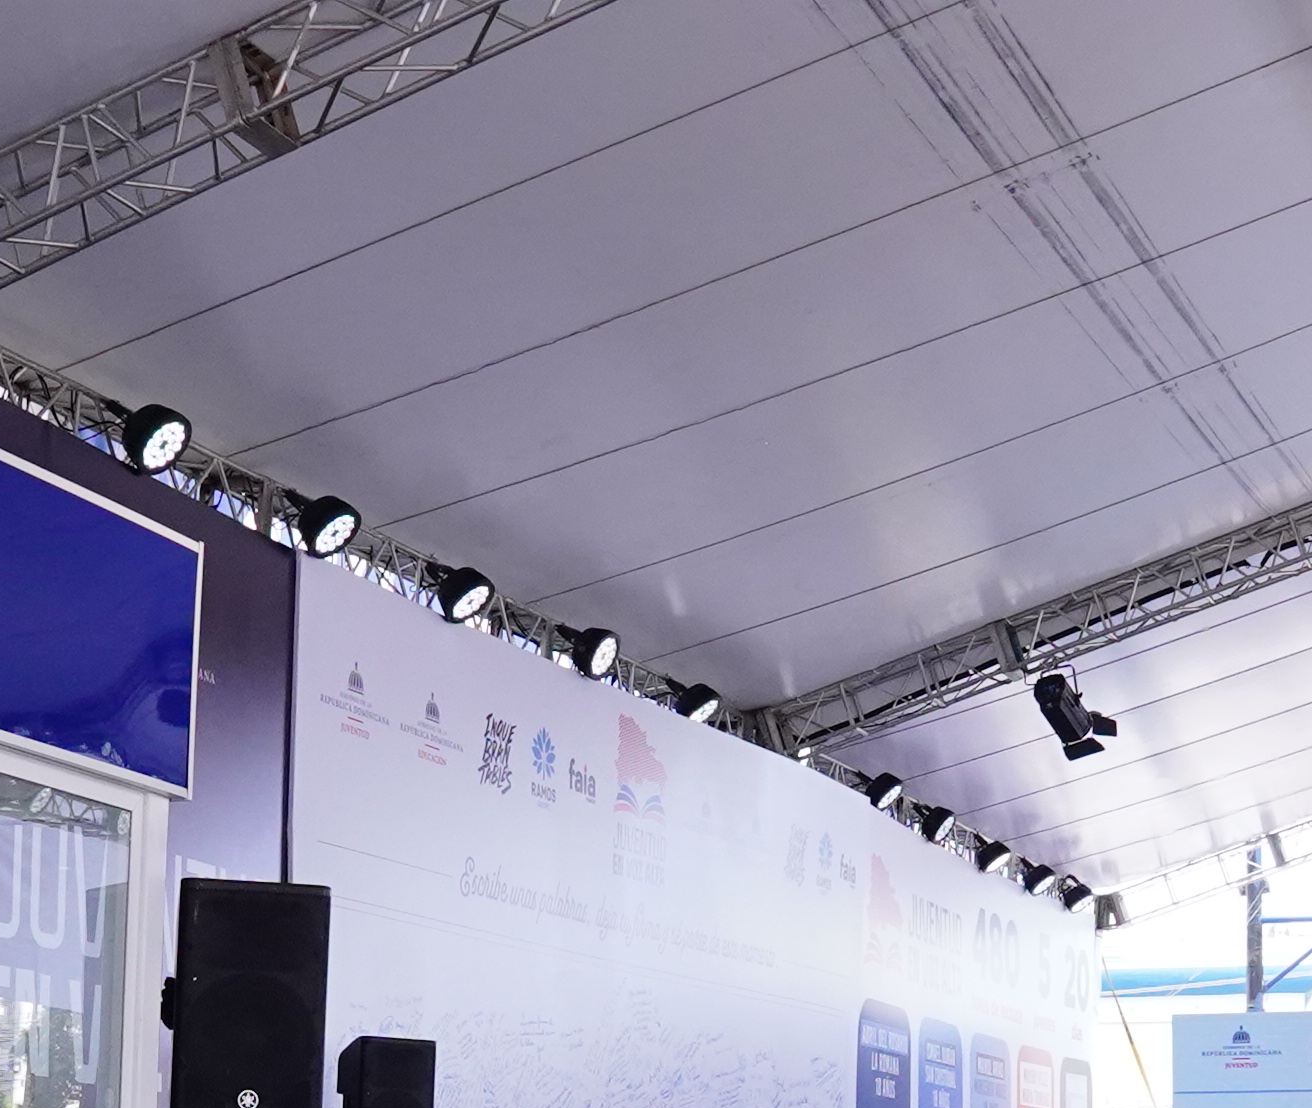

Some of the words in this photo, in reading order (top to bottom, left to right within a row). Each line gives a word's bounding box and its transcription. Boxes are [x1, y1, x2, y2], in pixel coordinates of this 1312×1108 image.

[530, 781, 557, 804] RAMOS
[568, 758, 596, 798] faia
[613, 822, 667, 862] JUVENTUD
[459, 855, 508, 903] Escribe
[612, 853, 624, 876] EN
[972, 906, 1020, 990] 480
[1037, 932, 1051, 1000] 5
[1064, 945, 1090, 1013] 20
[1224, 1061, 1259, 1070] JUVENTUD
